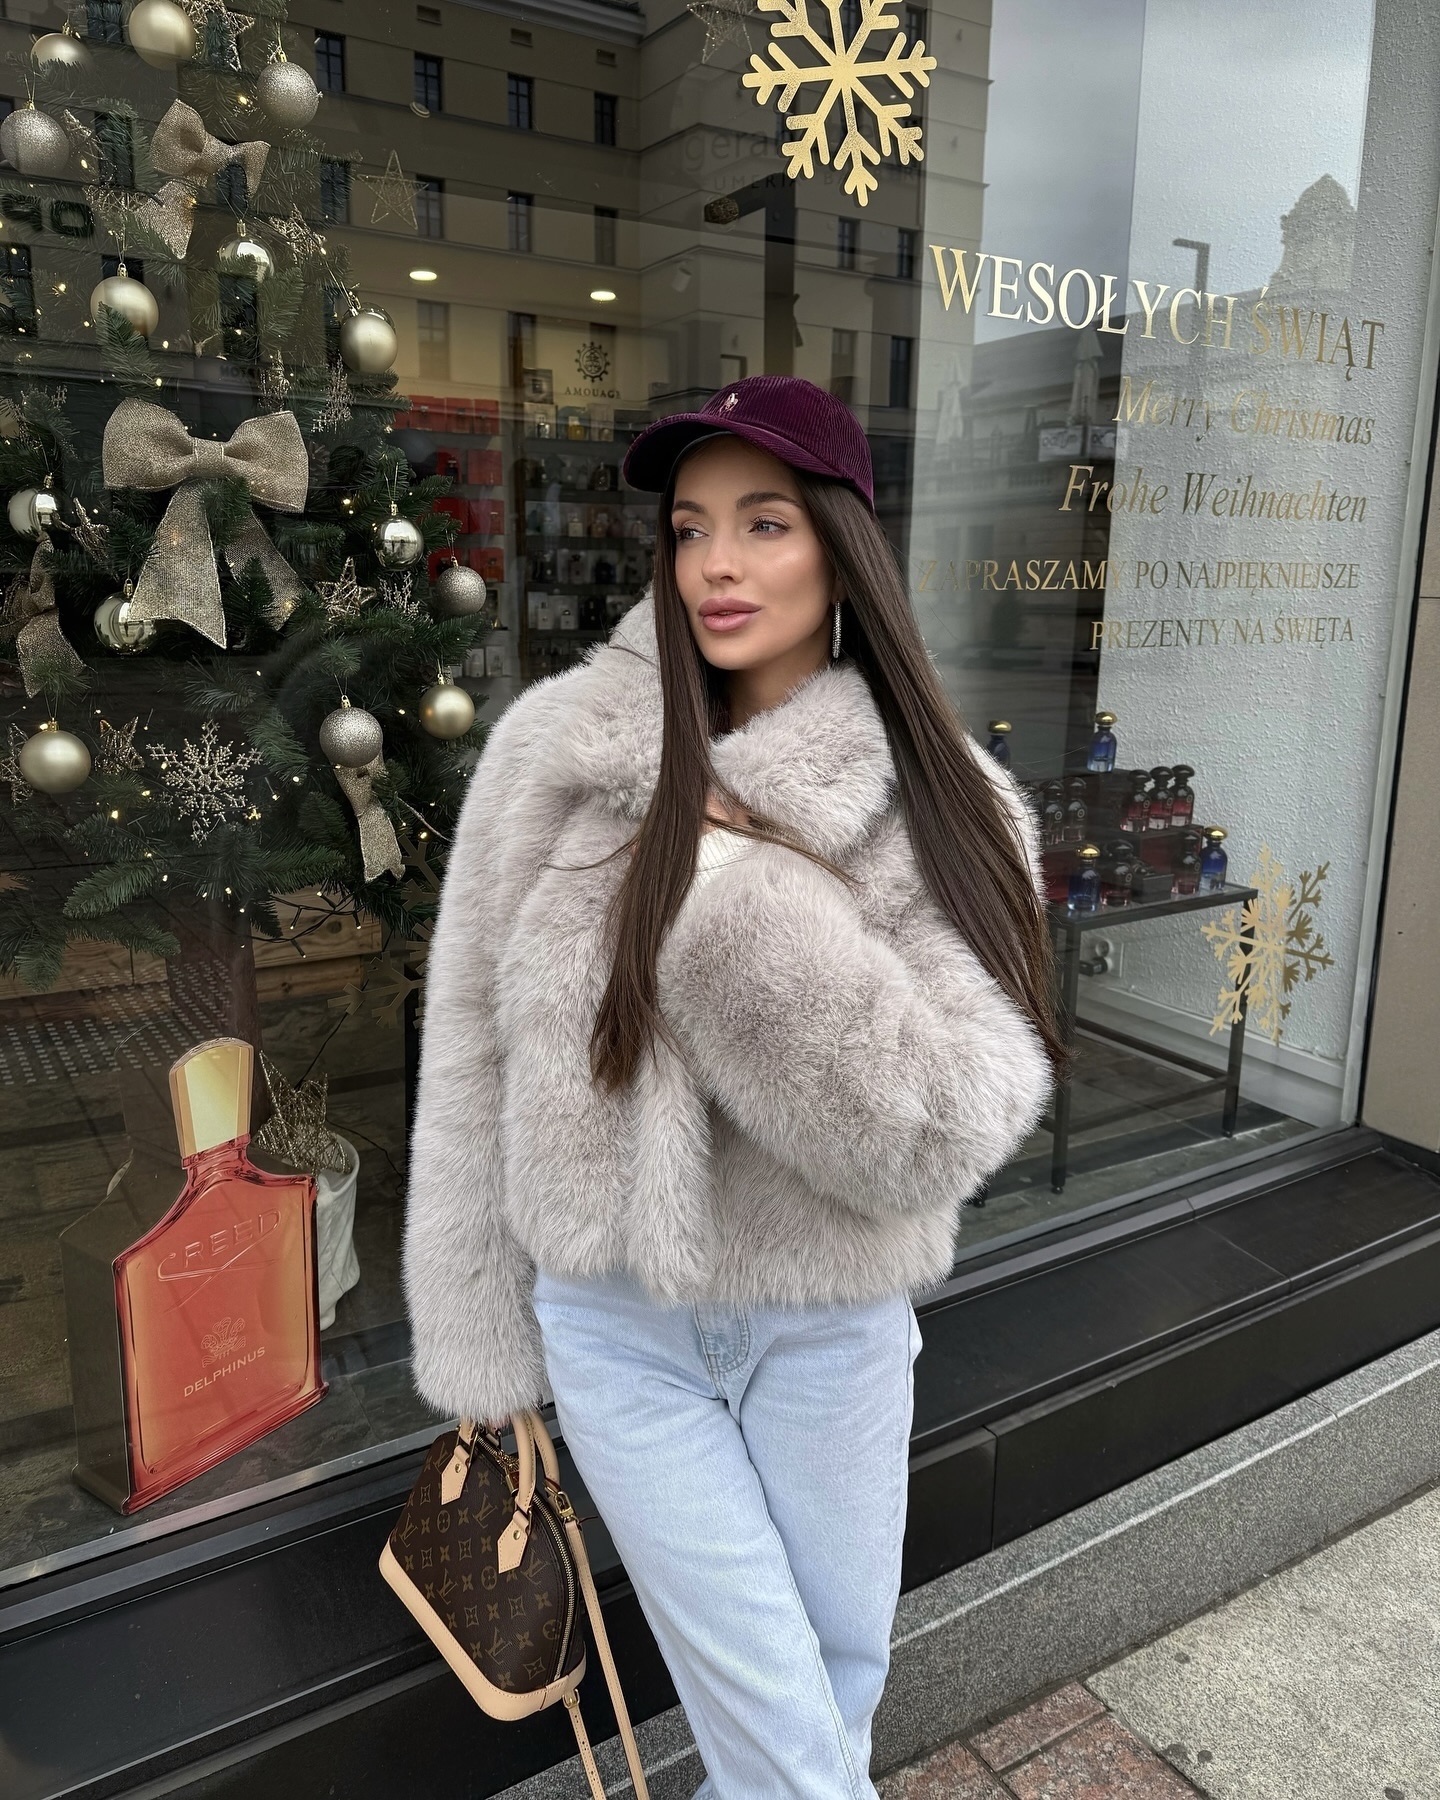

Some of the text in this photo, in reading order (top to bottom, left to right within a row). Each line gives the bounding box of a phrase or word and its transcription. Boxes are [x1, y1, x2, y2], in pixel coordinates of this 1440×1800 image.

[929, 244, 1385, 381] WESOŁYCH ŚWIĄT
[1112, 376, 1376, 445] Merry Christmas
[1058, 465, 1368, 523] Frohe Weihnachten
[917, 559, 1361, 597] ZAPRASZAMY PO NAJPIĘKNIEJSZE
[1090, 609, 1355, 651] PREZENTY NA ŚWIĘTA
[183, 1346, 266, 1398] DELPHINUS
